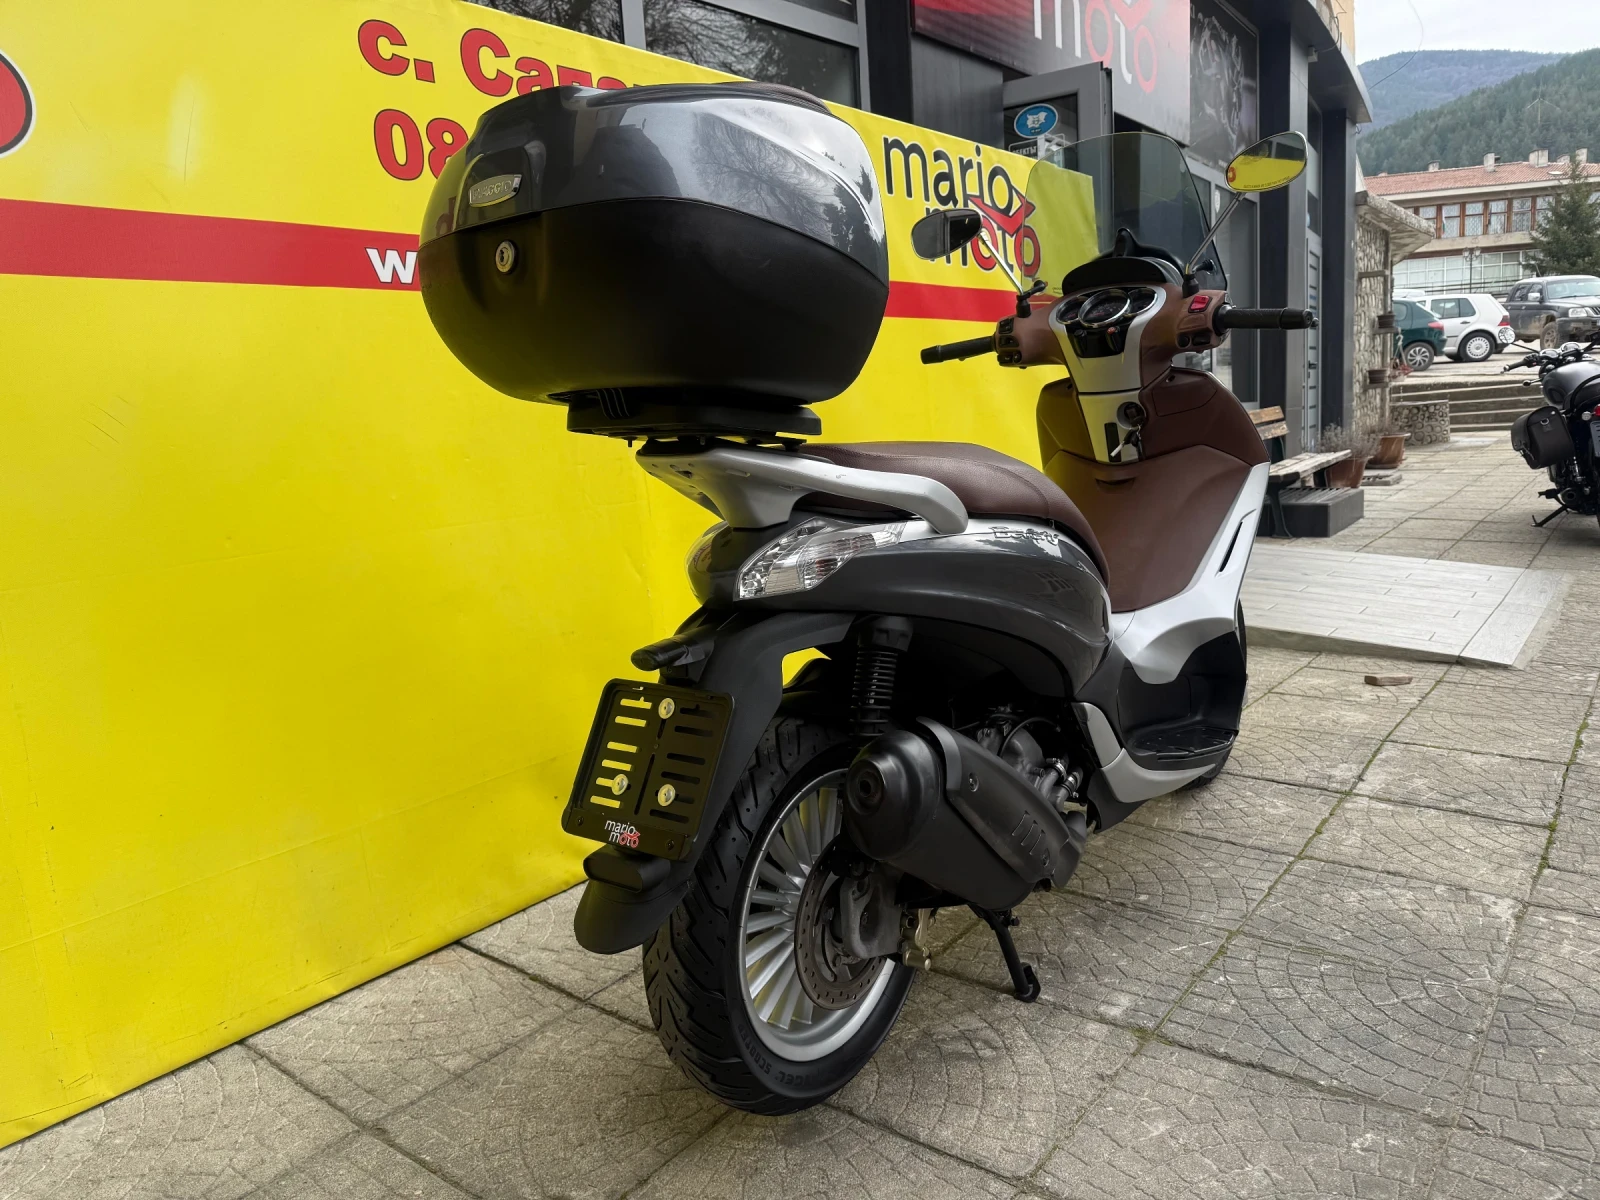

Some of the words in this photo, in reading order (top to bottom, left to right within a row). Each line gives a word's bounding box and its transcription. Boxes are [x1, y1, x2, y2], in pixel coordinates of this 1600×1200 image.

[883, 137, 1014, 216] mario
[604, 820, 636, 835] mario
[608, 831, 640, 849] moto
